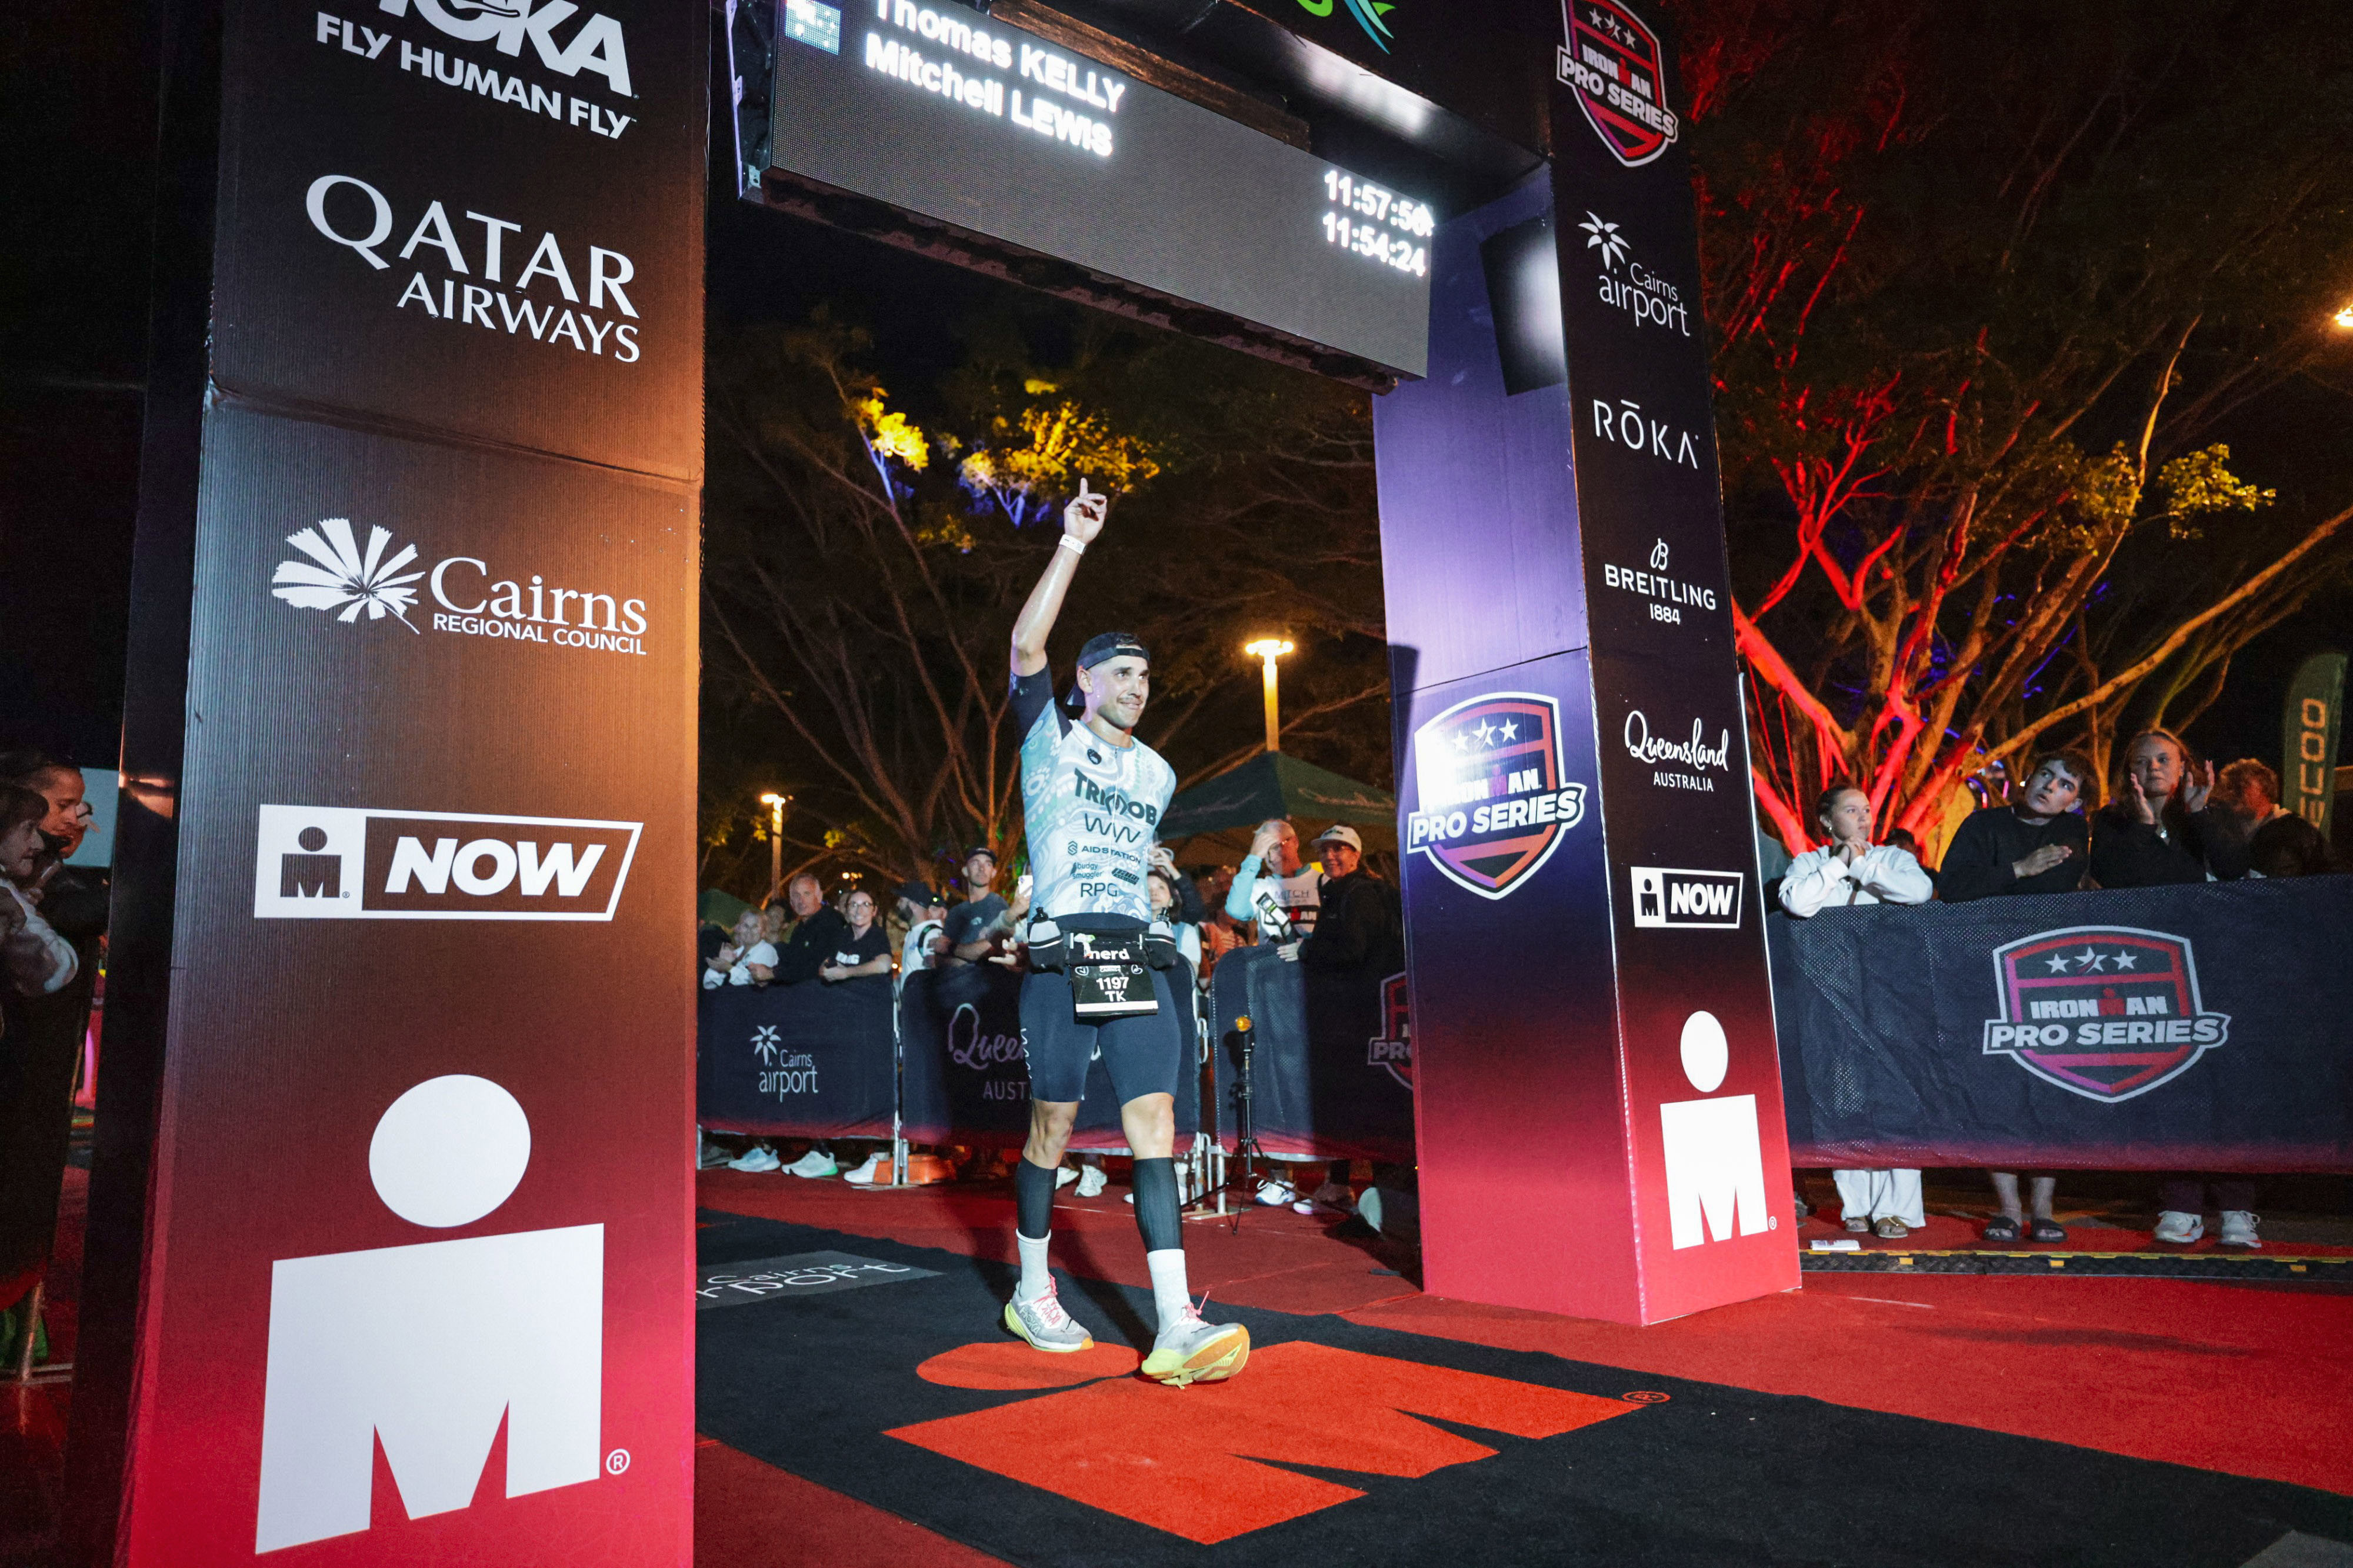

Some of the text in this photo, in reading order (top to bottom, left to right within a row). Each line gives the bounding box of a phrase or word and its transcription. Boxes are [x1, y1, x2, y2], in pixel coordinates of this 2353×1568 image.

[317, 11, 631, 139] FLY HUMAN FLY
[866, 32, 1112, 157] Mitchell LEWIS
[1021, 44, 1125, 112] KELLY
[1561, 54, 1675, 136] PRO SERIES
[306, 175, 639, 319] QATAR
[1322, 212, 1426, 277] 11:54:24
[1599, 268, 1690, 336] airport
[1630, 262, 1678, 302] Cairns
[396, 272, 640, 363] AIRWAYS
[430, 556, 648, 635] Cairns
[1604, 563, 1717, 610] BREITLING
[433, 613, 647, 655] REGIONAL COUNCIL
[1649, 603, 1681, 625] 1884
[1624, 710, 1729, 772] Queensland
[1653, 771, 1714, 792] AUSTRALIA
[1412, 790, 1578, 845] PRO SERIES
[385, 836, 607, 896] NOW
[1072, 870, 1102, 880] smuggler
[1076, 862, 1098, 870] budgy
[1080, 882, 1118, 898] RPG
[1671, 882, 1734, 916] NOW
[1096, 976, 1129, 990] 1197
[1104, 990, 1127, 1002] TK
[1991, 1017, 2220, 1048] PRO SERIES
[780, 1049, 812, 1067] Cairns
[759, 1062, 819, 1103] airport
[982, 1080, 1032, 1100] AUST
[695, 1263, 911, 1300] rport
[706, 1263, 852, 1284] Cairns
